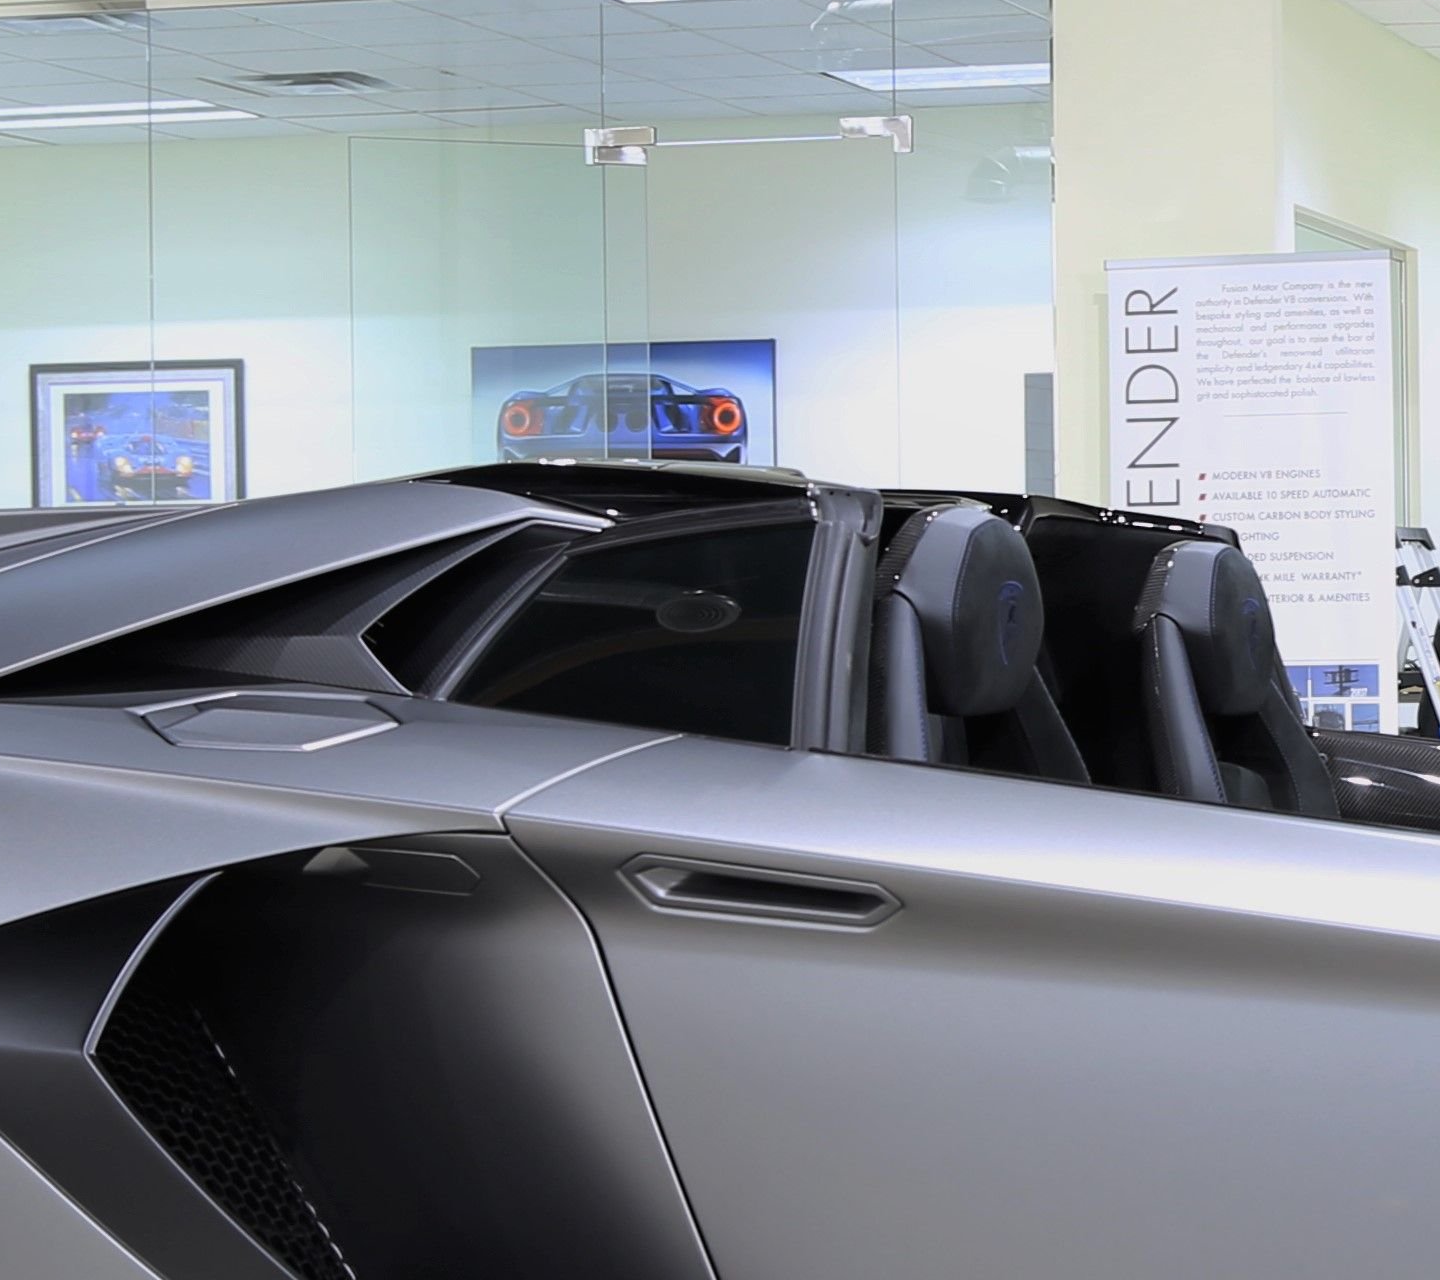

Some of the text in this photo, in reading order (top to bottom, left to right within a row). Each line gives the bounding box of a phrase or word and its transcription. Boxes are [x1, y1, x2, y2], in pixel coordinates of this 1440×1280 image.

[1222, 284, 1248, 293] Fusion
[1282, 281, 1324, 291] Company
[1338, 280, 1351, 288] the
[1195, 299, 1232, 308] authority
[1234, 298, 1241, 306] in
[1243, 296, 1282, 305] Defender
[1284, 295, 1296, 303] V8
[1353, 292, 1374, 302] With
[1195, 311, 1231, 321] bespoke
[1235, 310, 1261, 320] styling
[1264, 309, 1281, 318] and
[1343, 306, 1360, 315] well
[1196, 320, 1375, 333] mechanical and performance upgrades
[1266, 335, 1286, 346] goal
[1309, 334, 1329, 342] raise
[1332, 333, 1344, 342] the
[1347, 333, 1363, 341] bar
[1366, 332, 1375, 341] of
[1196, 352, 1209, 360] the
[1280, 347, 1323, 357] renowned
[1335, 347, 1375, 355] utilitarian
[1196, 364, 1234, 374] simplicity
[1236, 363, 1253, 372] and
[1255, 362, 1303, 373] ledgendary
[1305, 361, 1322, 369] 4x4
[1197, 373, 1375, 386] We have perfected the balance of lawless
[1125, 287, 1180, 507] ENDER
[1197, 391, 1210, 402] grit
[1212, 390, 1229, 399] and
[1231, 388, 1289, 400] sophistocated
[1212, 469, 1321, 480] MODERN V8 ENGINES
[1212, 488, 1372, 500] AVAILABLE 10 SPEED AUTOMATIC
[1212, 510, 1375, 521] CUSTOM CARBON BODY STYLING
[1240, 532, 1280, 541] GHTING
[1270, 552, 1334, 561] SUSPENSION
[1273, 573, 1296, 582] MILE
[1269, 593, 1370, 603] TERIOR & AMENITIES
